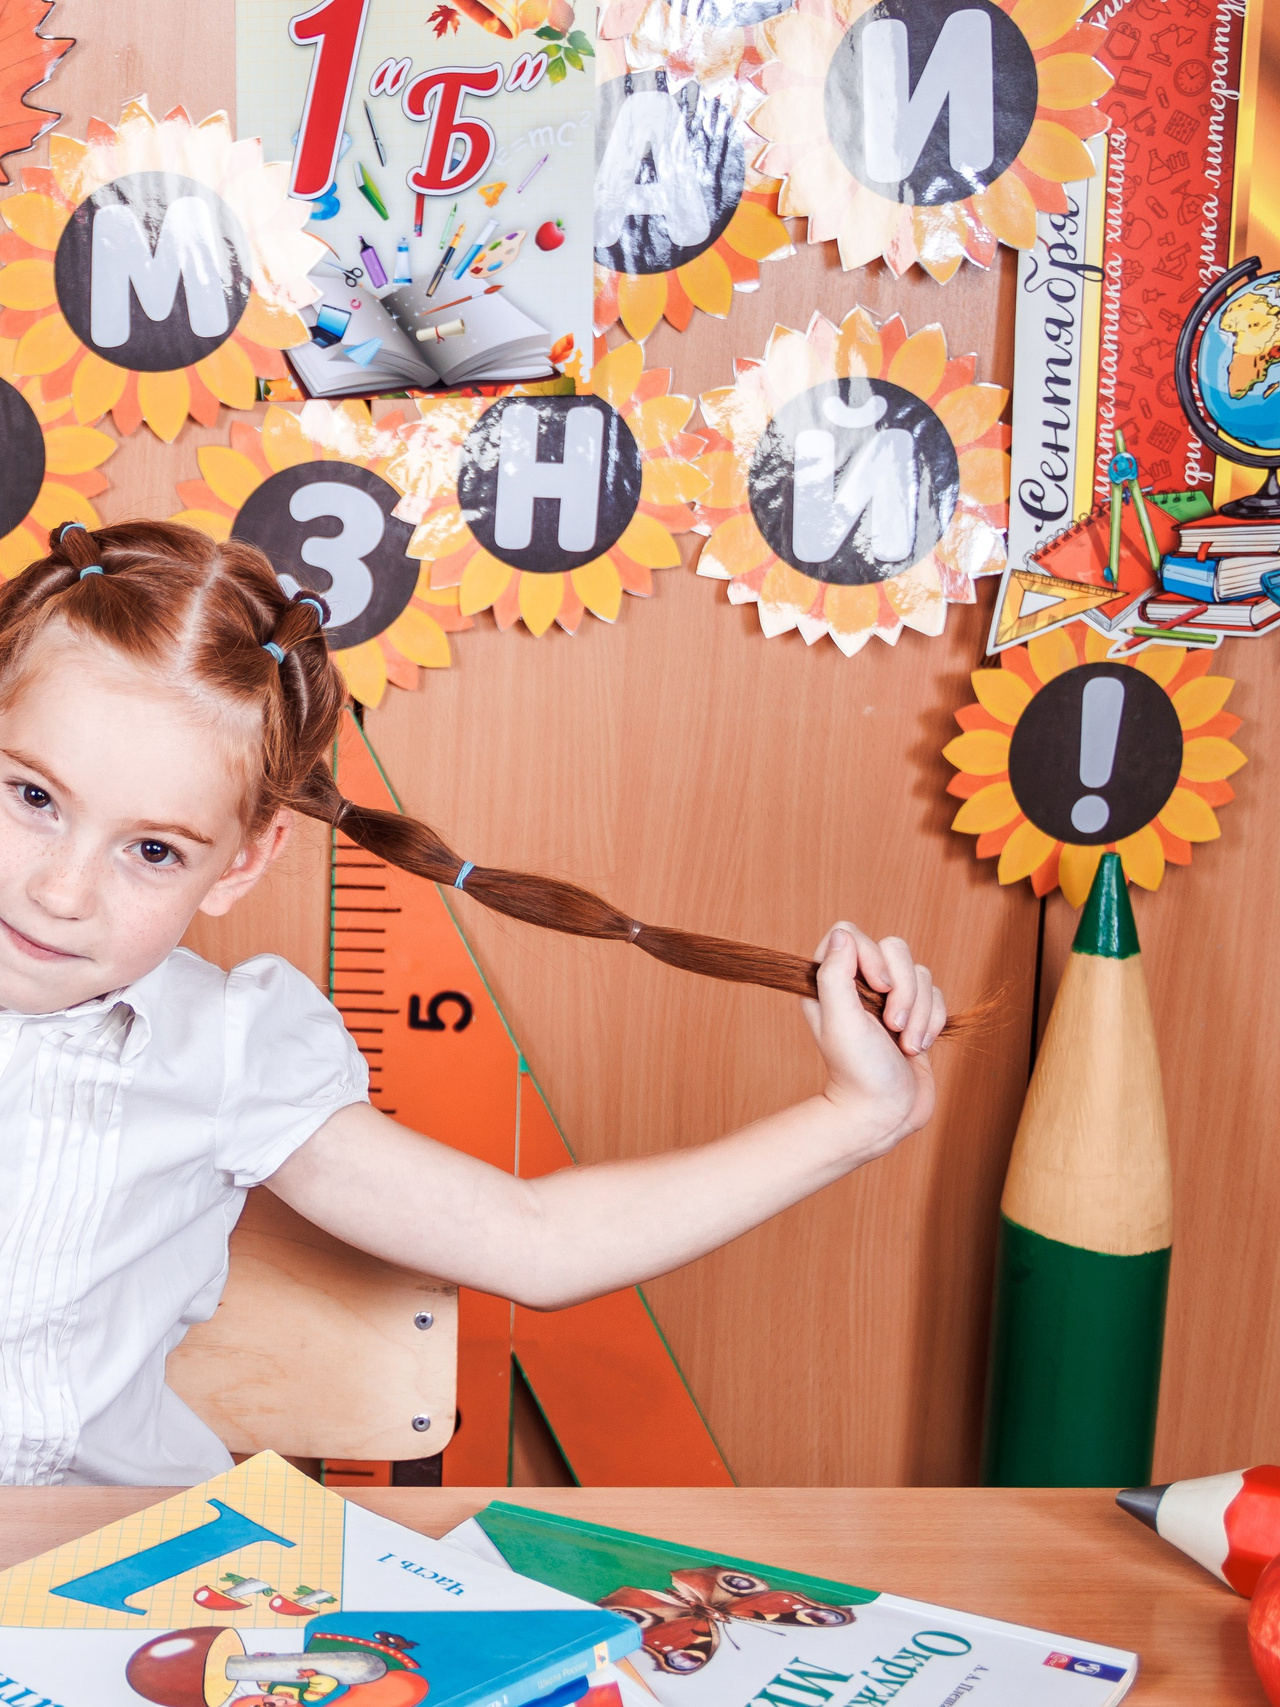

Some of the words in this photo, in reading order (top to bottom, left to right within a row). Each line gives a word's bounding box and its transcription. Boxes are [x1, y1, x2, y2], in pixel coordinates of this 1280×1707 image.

[1106, 127, 1129, 244] химия
[1018, 196, 1106, 533] Сентября
[1094, 252, 1124, 497] математика
[408, 991, 474, 1032] 5
[842, 1629, 973, 1707] Окруж
